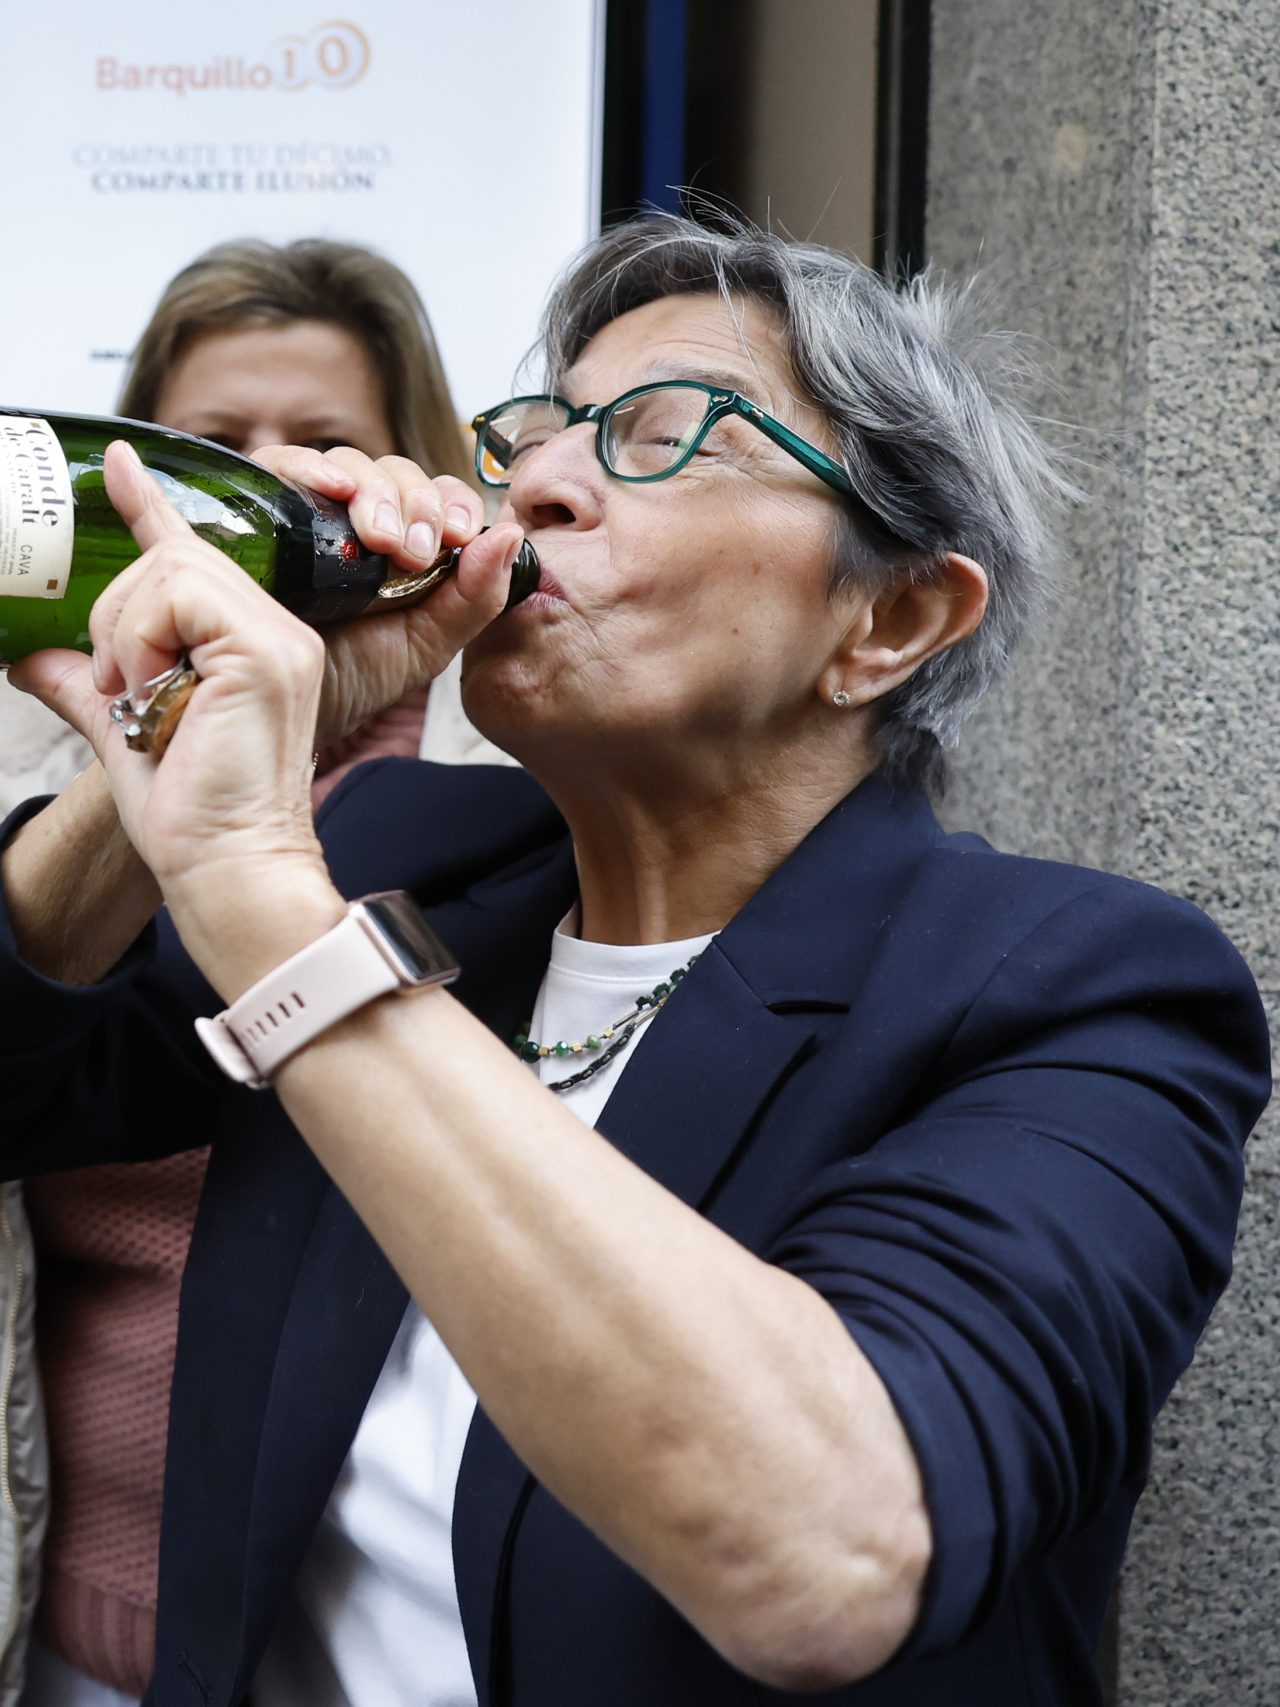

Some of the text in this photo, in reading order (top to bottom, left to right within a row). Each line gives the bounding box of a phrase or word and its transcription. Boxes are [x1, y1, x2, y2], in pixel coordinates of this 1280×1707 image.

[95, 56, 272, 98] Barquillo
[72, 143, 218, 168] COMPARTE
[231, 143, 266, 167] TU
[90, 169, 245, 193] COMPARTE
[3, 427, 23, 447] de
[15, 453, 40, 524] Caralt
[25, 429, 66, 527] Conde
[17, 544, 33, 576] CAVA
